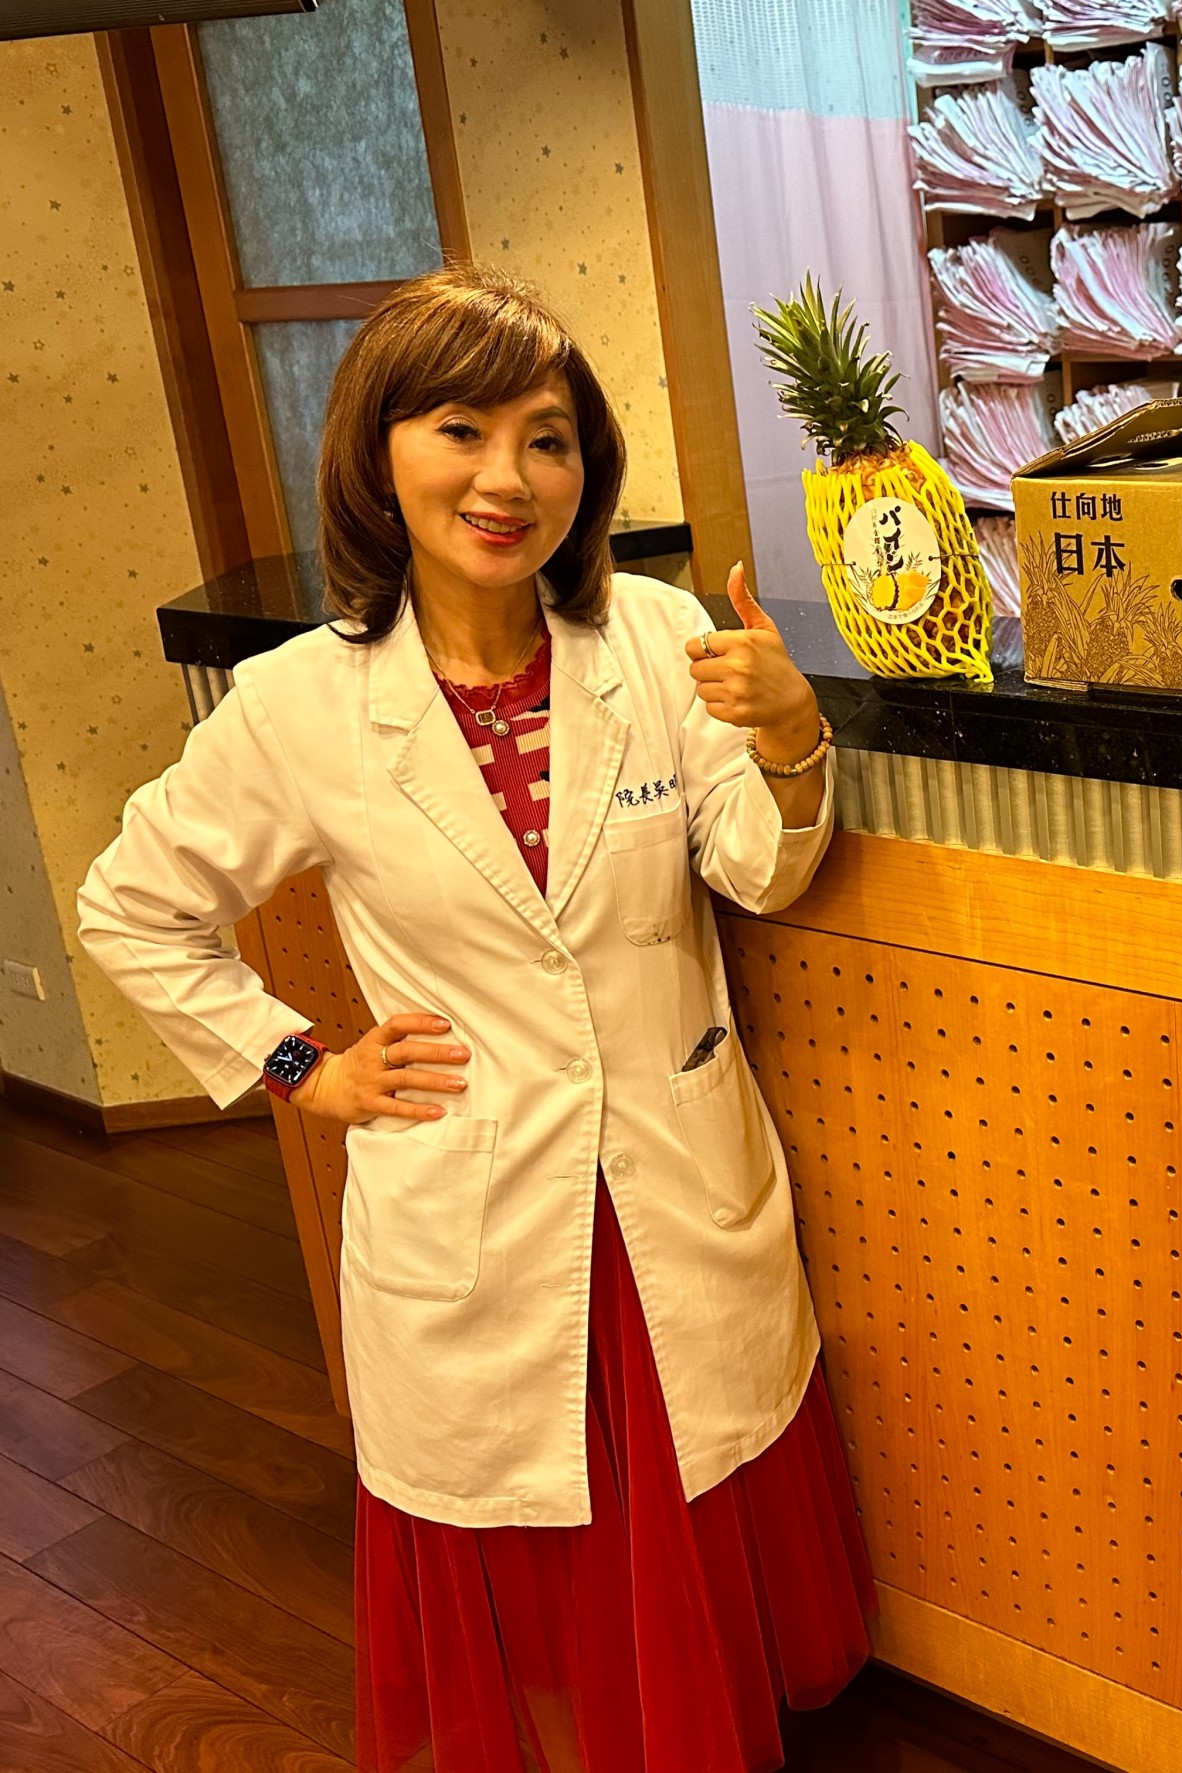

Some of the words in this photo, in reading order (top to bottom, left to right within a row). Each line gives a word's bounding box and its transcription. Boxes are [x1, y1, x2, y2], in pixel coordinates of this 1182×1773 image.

[1050, 491, 1123, 522] 仕向地
[878, 505, 905, 573] パイン
[1054, 532, 1126, 577] 日本
